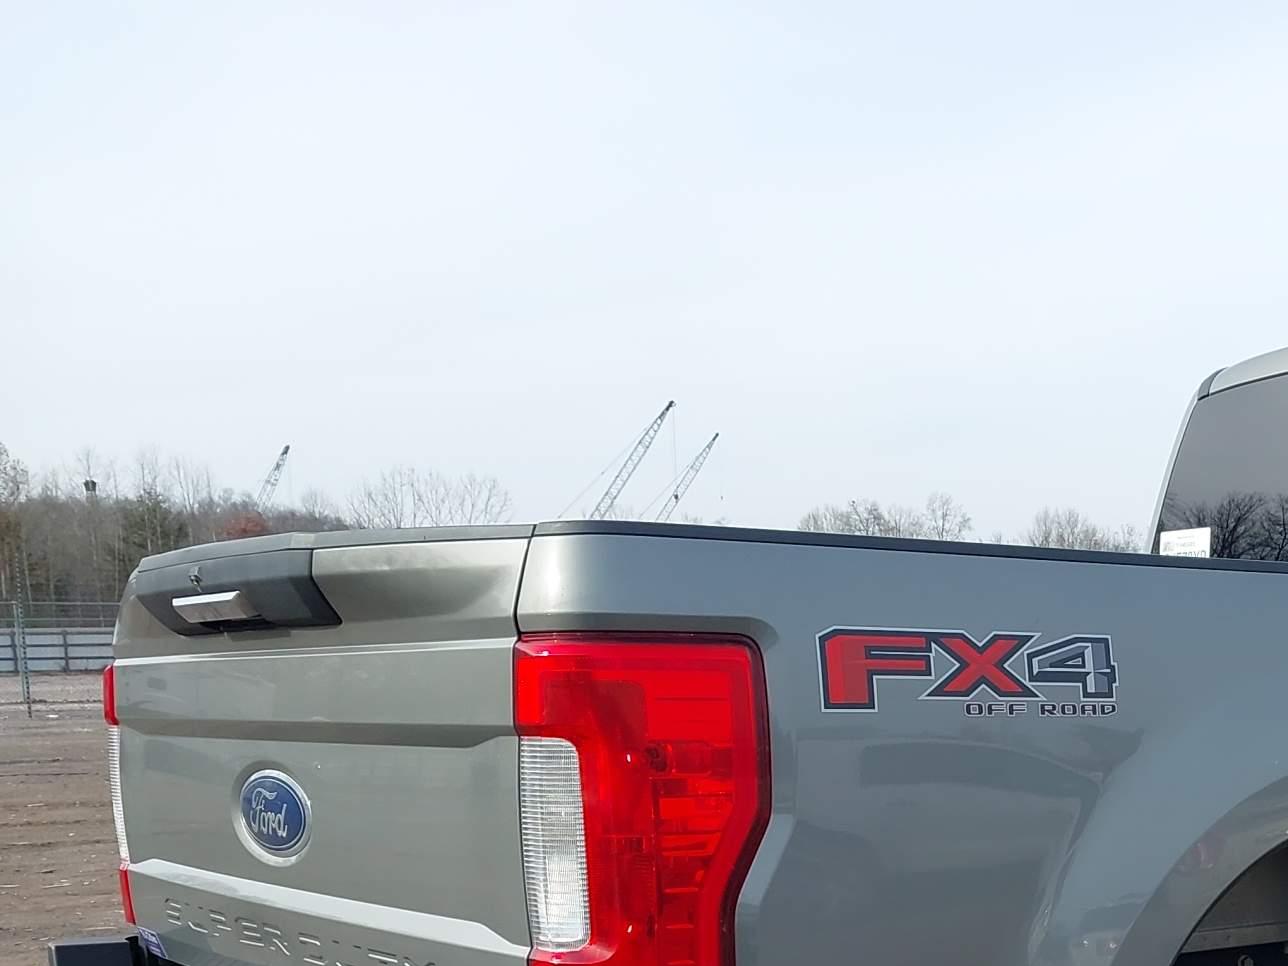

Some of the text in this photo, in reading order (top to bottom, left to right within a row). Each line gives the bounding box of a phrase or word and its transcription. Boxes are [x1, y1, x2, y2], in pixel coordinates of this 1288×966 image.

[815, 625, 1119, 712] FX4
[964, 702, 1118, 717] OFF ROAD
[250, 786, 290, 838] Ford
[164, 898, 290, 956] SUPER
